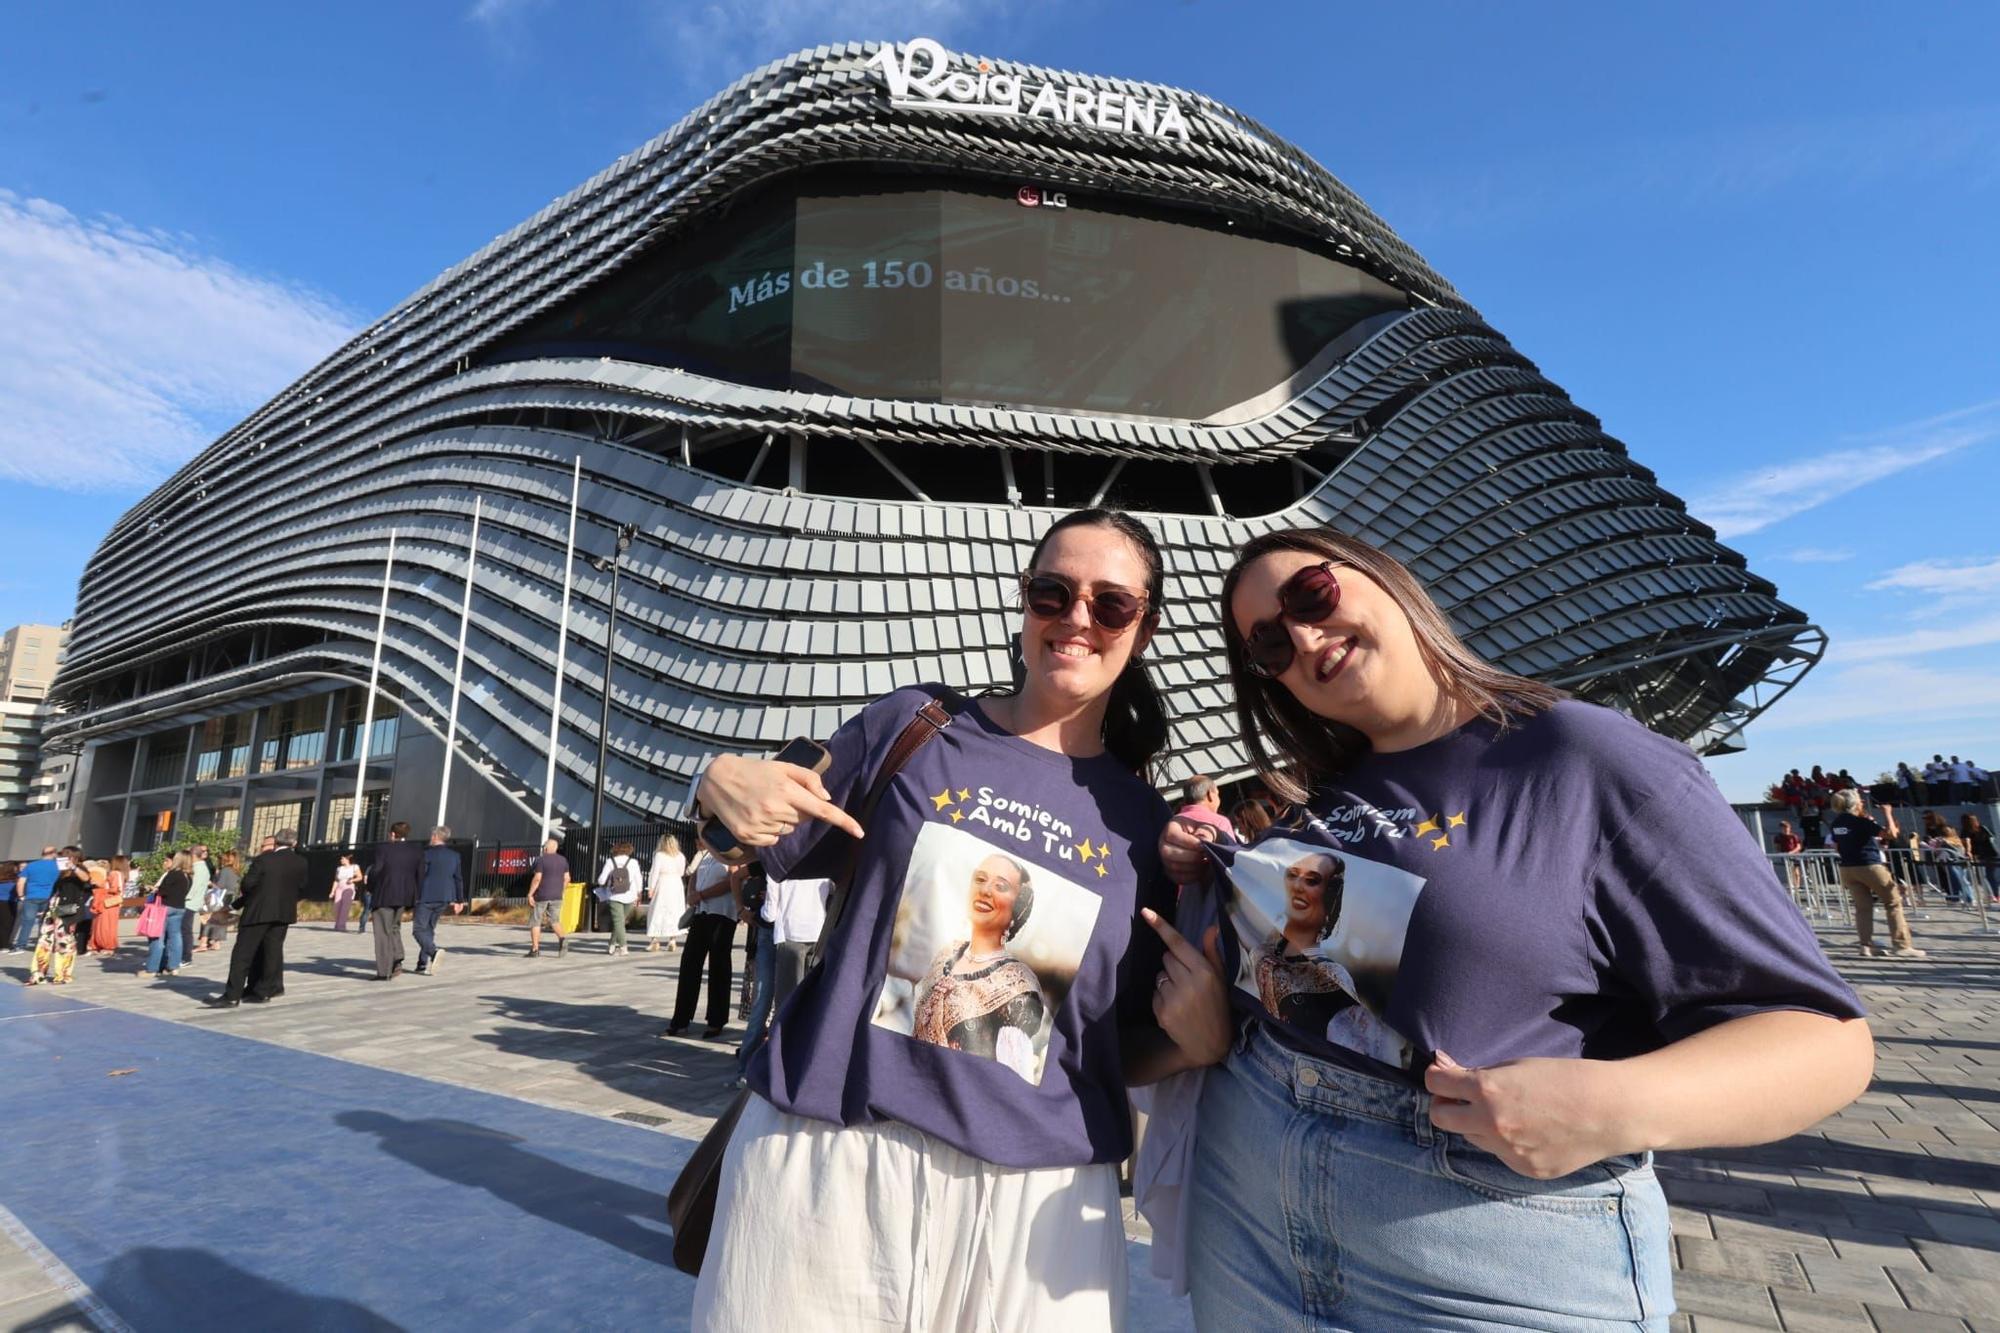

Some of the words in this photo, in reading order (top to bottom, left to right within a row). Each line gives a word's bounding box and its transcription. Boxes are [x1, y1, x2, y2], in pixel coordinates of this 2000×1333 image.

[865, 37, 1022, 115] Roig
[1027, 81, 1191, 142] ARENA
[1042, 190, 1068, 208] LG
[728, 270, 790, 314] Más
[800, 262, 850, 290] de
[862, 261, 933, 290] 150
[944, 267, 1072, 304] años...
[967, 805, 1032, 842] Amb
[1042, 831, 1073, 861] Tu
[977, 786, 1073, 838] Somiem
[1370, 819, 1408, 839] Tu
